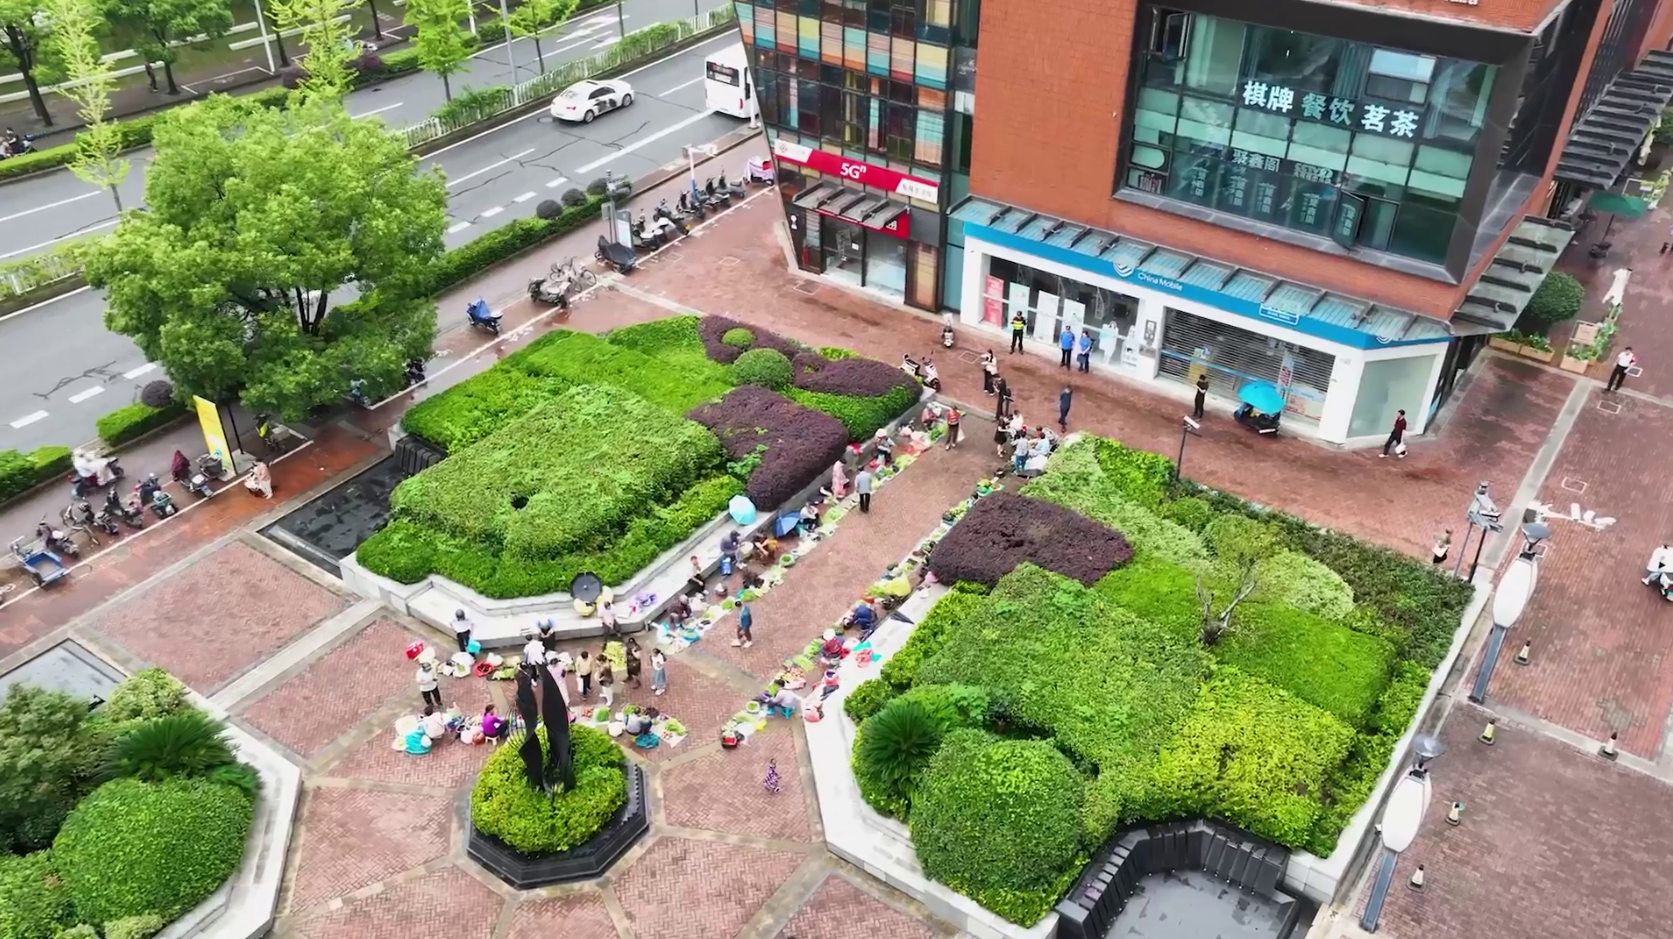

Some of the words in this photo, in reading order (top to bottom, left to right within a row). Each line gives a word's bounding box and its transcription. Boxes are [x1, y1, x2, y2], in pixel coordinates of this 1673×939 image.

[1242, 80, 1295, 113] 棋牌
[1301, 92, 1355, 126] 餐饮
[1361, 104, 1420, 138] 茗茶
[1137, 271, 1159, 285] China
[1159, 279, 1183, 292] Mobile
